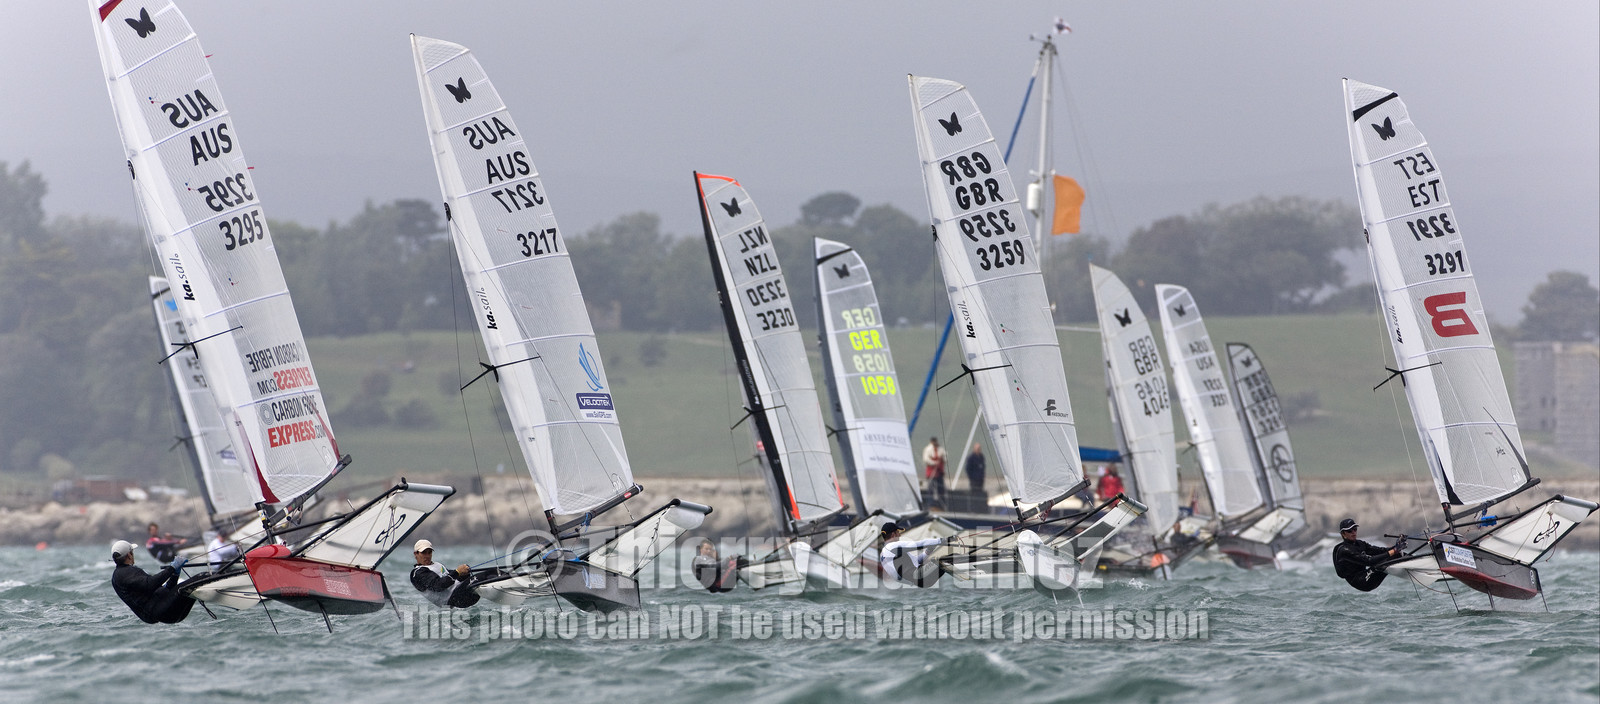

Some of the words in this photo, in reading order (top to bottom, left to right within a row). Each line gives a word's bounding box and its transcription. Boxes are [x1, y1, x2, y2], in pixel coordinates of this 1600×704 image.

[189, 123, 233, 166] AUS
[485, 151, 530, 185] AUS
[955, 177, 1005, 211] GBR
[1407, 179, 1440, 208] EST
[218, 209, 264, 251] 3295
[516, 227, 559, 258] 3217
[744, 253, 777, 277] NZL
[976, 239, 1025, 271] 3259
[1424, 249, 1465, 276] 3291
[756, 307, 795, 331] 3230
[849, 329, 883, 351] GER
[1134, 352, 1160, 375] GBR
[861, 376, 897, 396] 1058
[271, 397, 303, 422] CARBON
